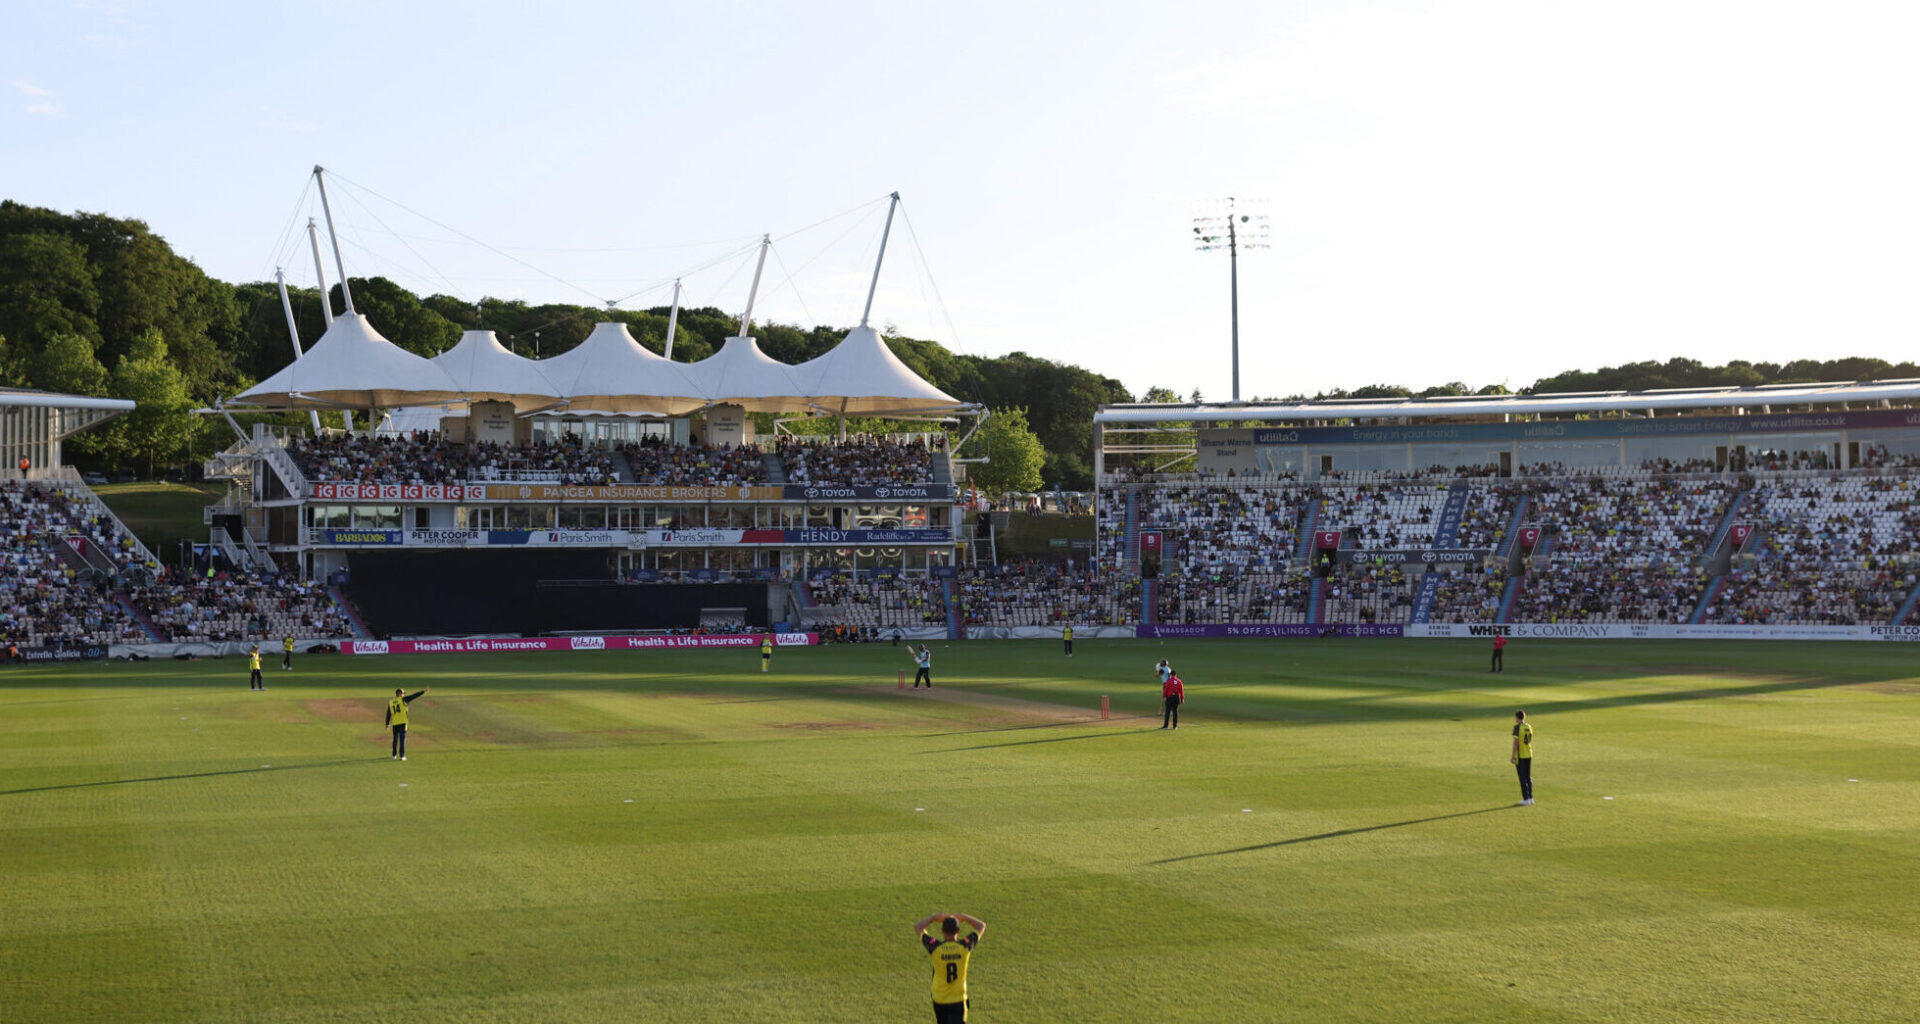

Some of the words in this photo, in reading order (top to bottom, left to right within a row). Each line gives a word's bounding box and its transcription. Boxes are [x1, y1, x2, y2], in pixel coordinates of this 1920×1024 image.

[1751, 417, 1846, 429] www.utilita.co.uk
[1259, 434, 1290, 442] utilita
[1353, 430, 1389, 441] Energy
[1391, 430, 1400, 439] in
[1402, 430, 1428, 441] your
[1429, 428, 1459, 438] hands
[1201, 439, 1226, 447] Shane
[1216, 449, 1237, 457] Stand
[543, 487, 595, 498] PANGEA
[599, 487, 667, 498] INSURANCE
[671, 488, 727, 498] BROKERS
[821, 489, 856, 497] TOYOTA
[892, 489, 927, 497] TOYOTA
[412, 531, 439, 539] PETER
[441, 531, 479, 539] COOPER
[673, 532, 695, 543] Paris
[697, 531, 725, 542] Smith
[800, 531, 849, 541] HENDY
[1526, 531, 1534, 540] C
[1737, 527, 1746, 537] D
[335, 533, 387, 543] BARBADOS
[560, 532, 583, 543] Paris
[584, 532, 612, 543] Smith
[1148, 535, 1154, 544] B
[1324, 533, 1333, 542] C
[1440, 553, 1475, 562] TOYOTA
[1153, 625, 1206, 637] AMBASSADOR
[1227, 627, 1240, 635] 5%
[1242, 627, 1260, 635] OFF
[1265, 626, 1310, 637] SAILINGS
[1346, 627, 1375, 635] CODE
[1517, 626, 1528, 636] &
[1532, 625, 1610, 637] COMPANY
[1871, 626, 1902, 635] PETER
[572, 638, 604, 649] Vitality
[628, 637, 665, 647] Health
[668, 637, 676, 646] &
[677, 637, 698, 646] Life
[700, 636, 753, 646] insurance
[776, 634, 808, 645] Vitality
[354, 642, 388, 654] Vitality
[414, 642, 452, 651] Health
[456, 642, 464, 650] &
[466, 641, 488, 650] Life
[492, 640, 547, 650] insurance
[26, 650, 52, 660] Estrella
[392, 704, 401, 714] 14
[946, 962, 958, 984] 8
